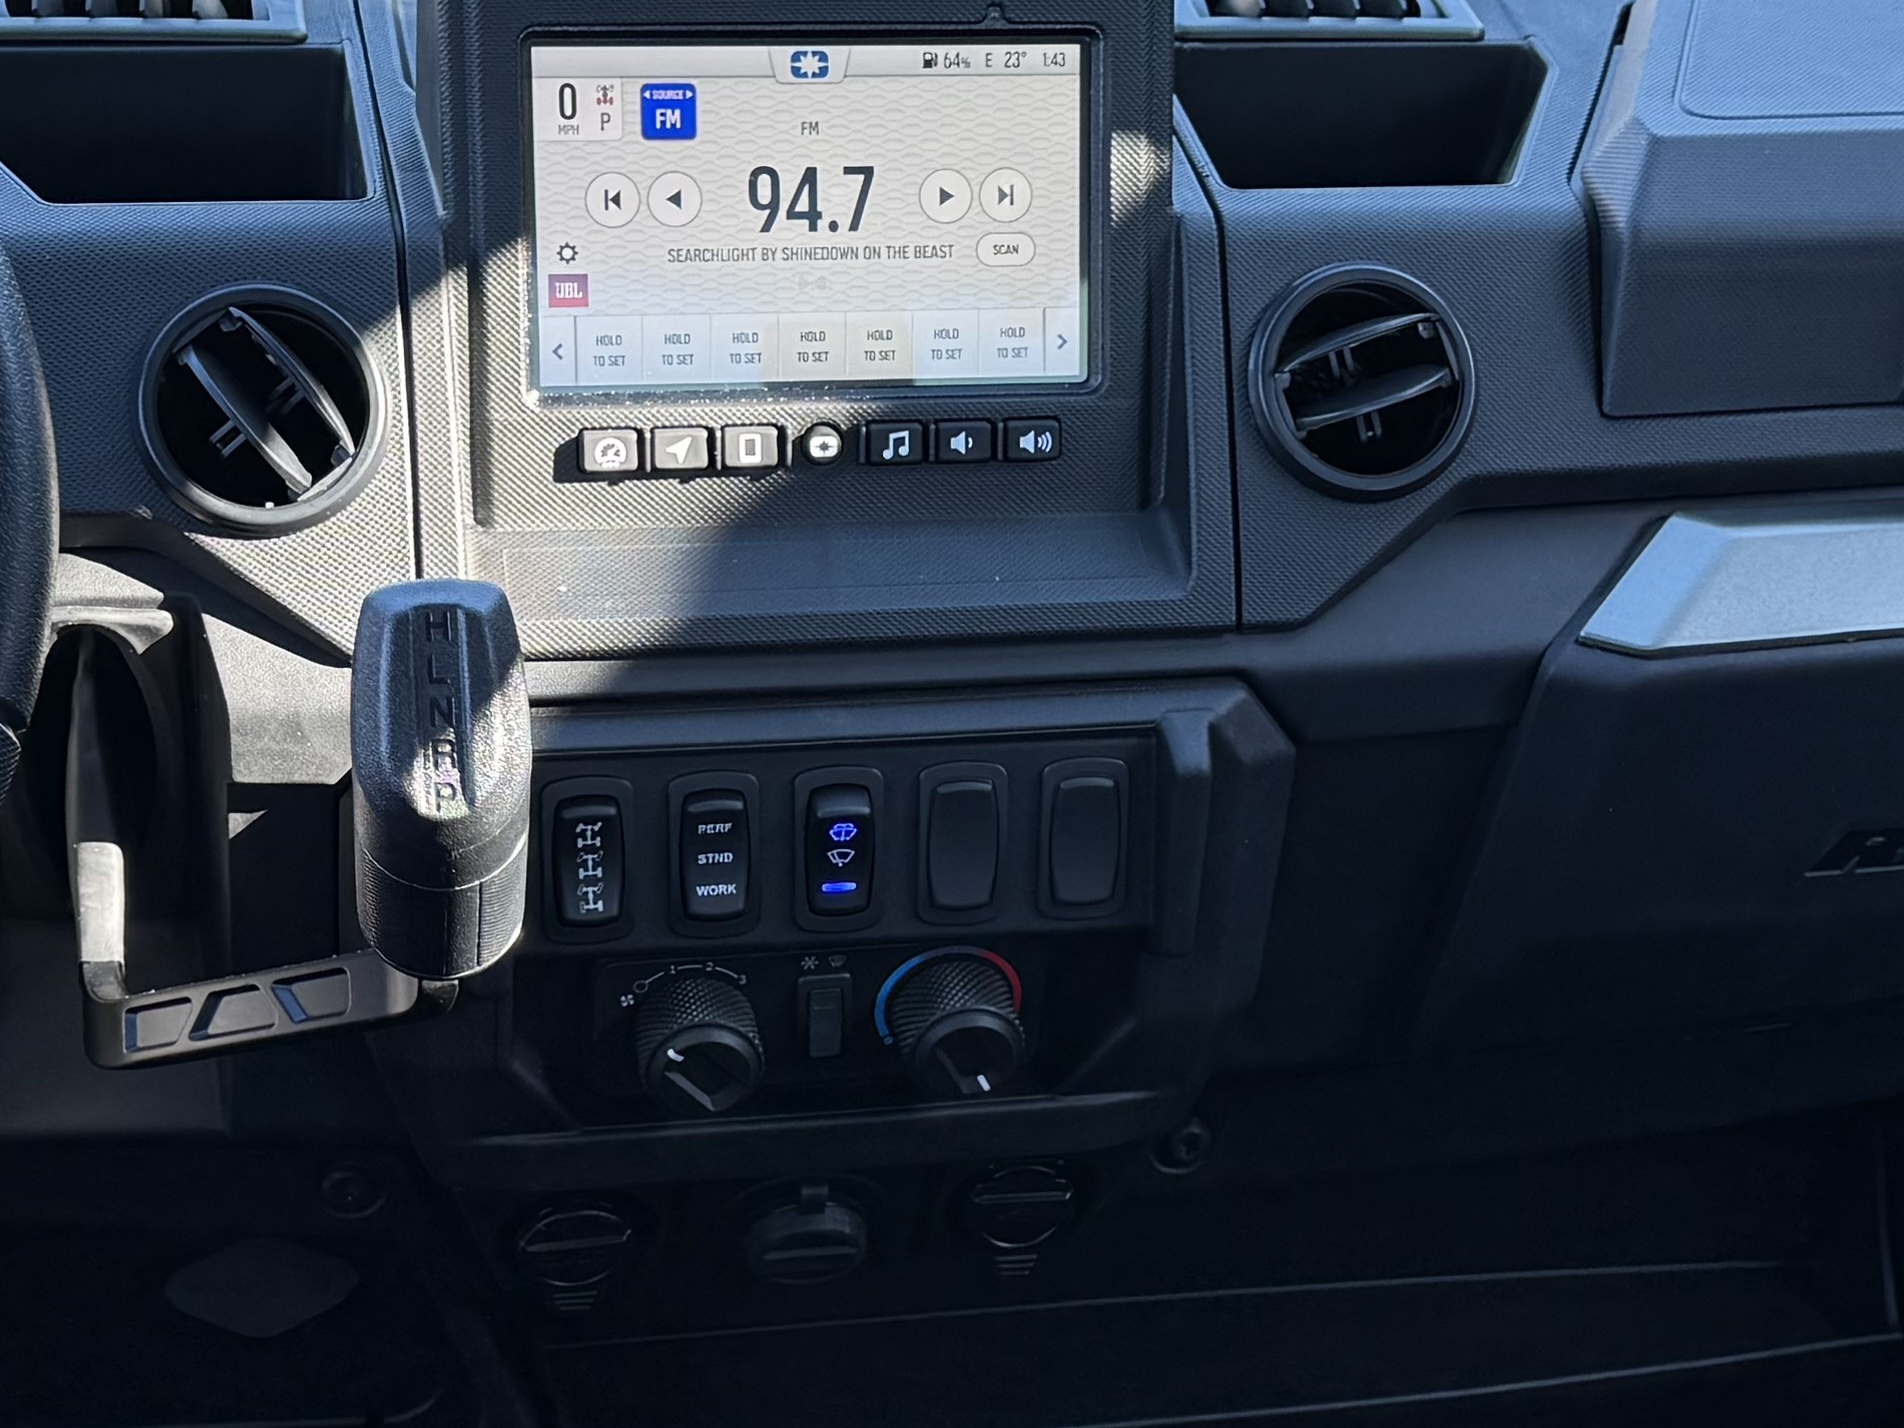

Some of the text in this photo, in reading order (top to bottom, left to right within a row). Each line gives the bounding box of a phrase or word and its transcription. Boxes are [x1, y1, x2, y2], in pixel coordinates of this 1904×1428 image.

[985, 53, 993, 68] E
[558, 82, 577, 120] 0
[652, 90, 684, 100] SOURCE
[600, 112, 611, 132] P
[655, 109, 682, 129] FM
[558, 124, 579, 135] MPH
[801, 122, 820, 135] FM
[748, 166, 874, 233] 94.7
[667, 244, 955, 263] SEARCHLIGHT BY SHINEDOWN ON THE BEAST
[992, 244, 1019, 255] SCAN
[732, 332, 758, 344] HOLD
[800, 331, 826, 342] HOLD
[867, 329, 893, 341] HOLD
[934, 328, 959, 340] HOLD
[1000, 327, 1025, 338] HOLD
[596, 334, 622, 346] HOLD
[664, 333, 690, 345] HOLD
[730, 353, 762, 364] TO SET
[797, 351, 829, 363] TO SET
[864, 350, 896, 362] TO SET
[931, 349, 962, 360] TO SET
[997, 347, 1028, 359] TO SET
[594, 355, 625, 367] TO SET
[662, 354, 694, 365] TO SET
[425, 611, 452, 642] H
[429, 696, 457, 728] N
[698, 822, 733, 834] PERF
[697, 852, 733, 865] STND
[696, 884, 736, 897] WORK
